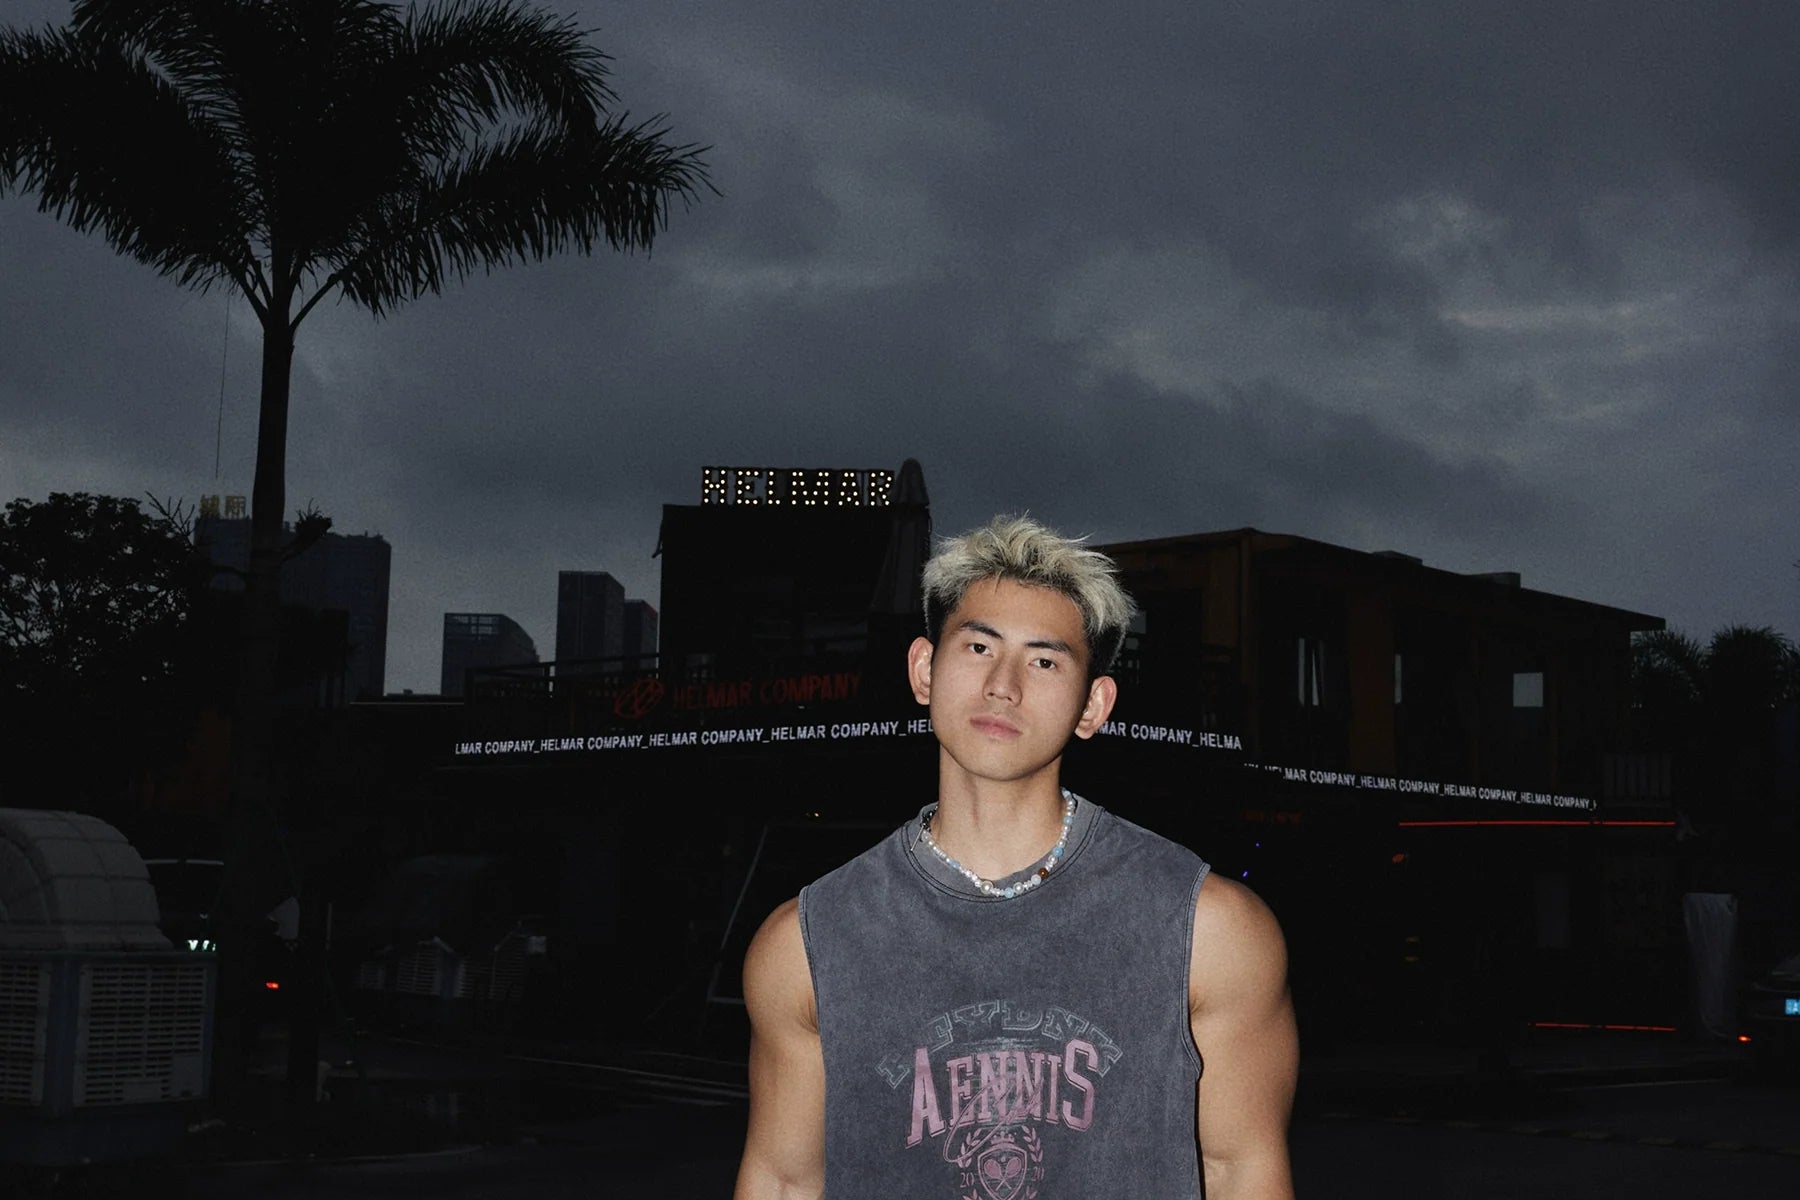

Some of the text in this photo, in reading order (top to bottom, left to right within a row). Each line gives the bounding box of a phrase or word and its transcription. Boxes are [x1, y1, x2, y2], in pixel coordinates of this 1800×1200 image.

[703, 468, 894, 506] HELMAR
[673, 671, 863, 710] HELMAR COMPANY
[1095, 721, 1127, 737] MAR
